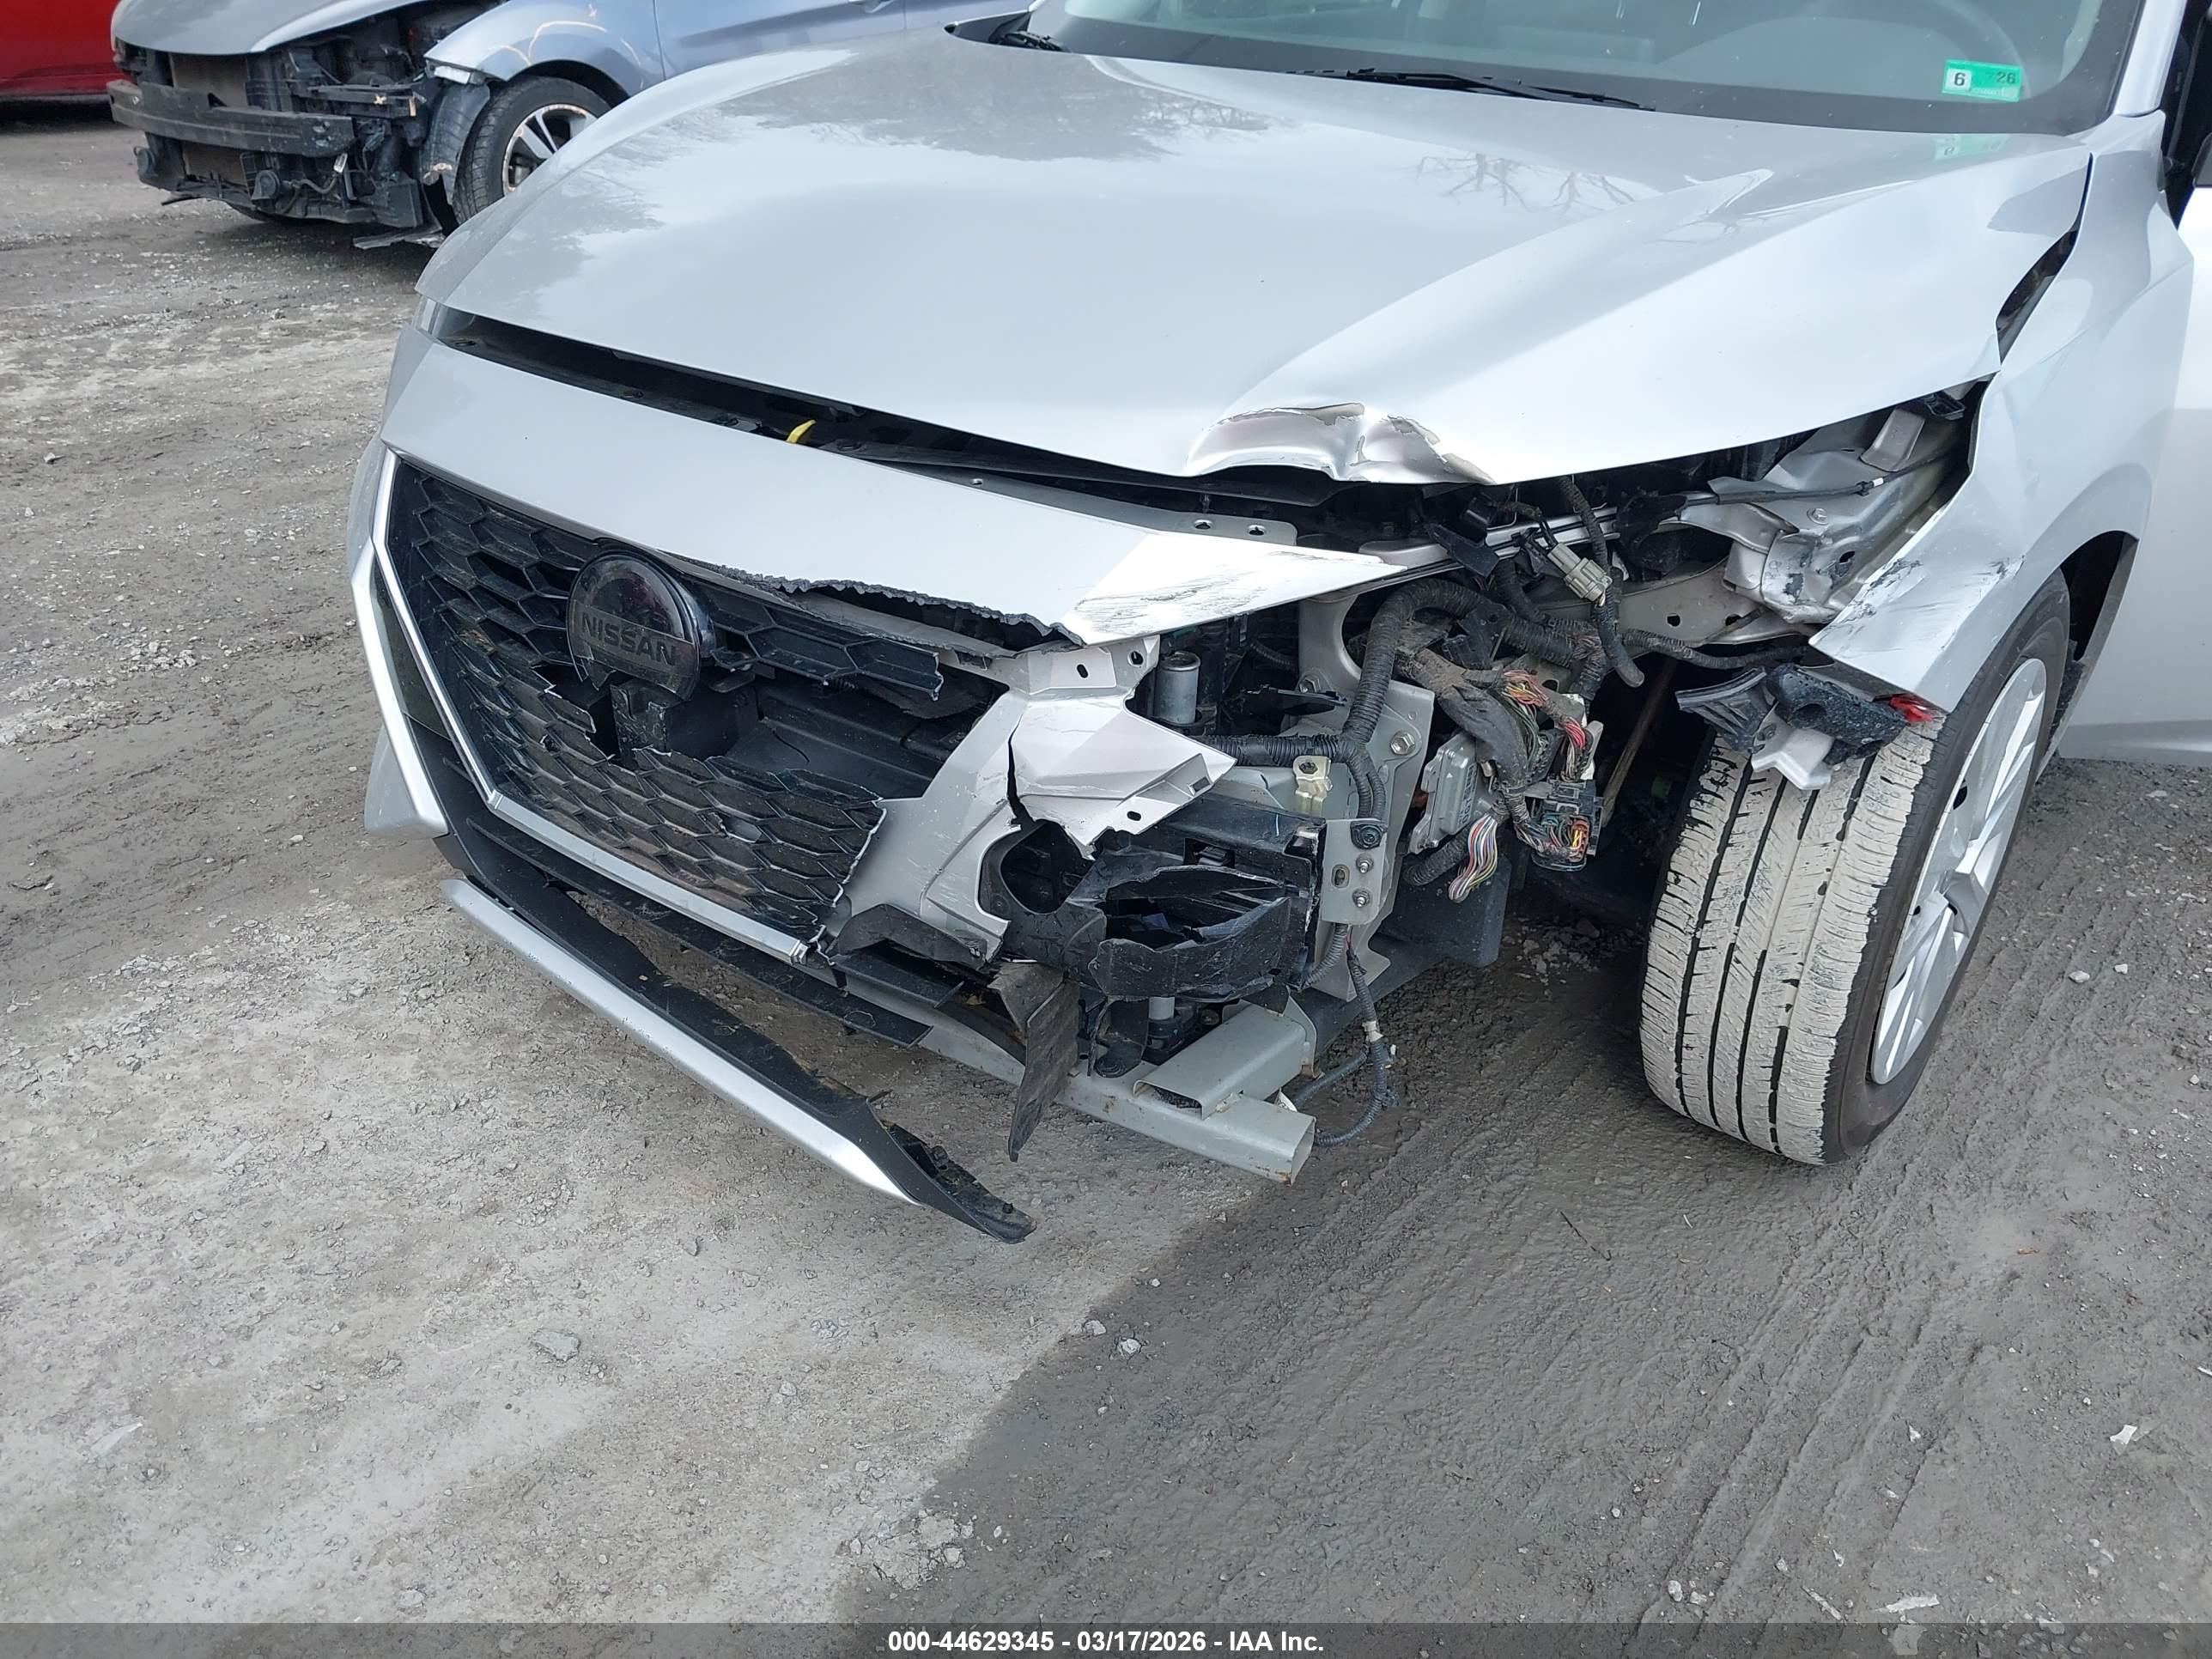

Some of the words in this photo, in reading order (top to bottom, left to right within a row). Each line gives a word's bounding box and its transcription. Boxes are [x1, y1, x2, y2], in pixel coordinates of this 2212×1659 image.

[1954, 72, 1966, 86] 6
[1996, 71, 2015, 84] 26
[581, 612, 676, 665] NISSAN
